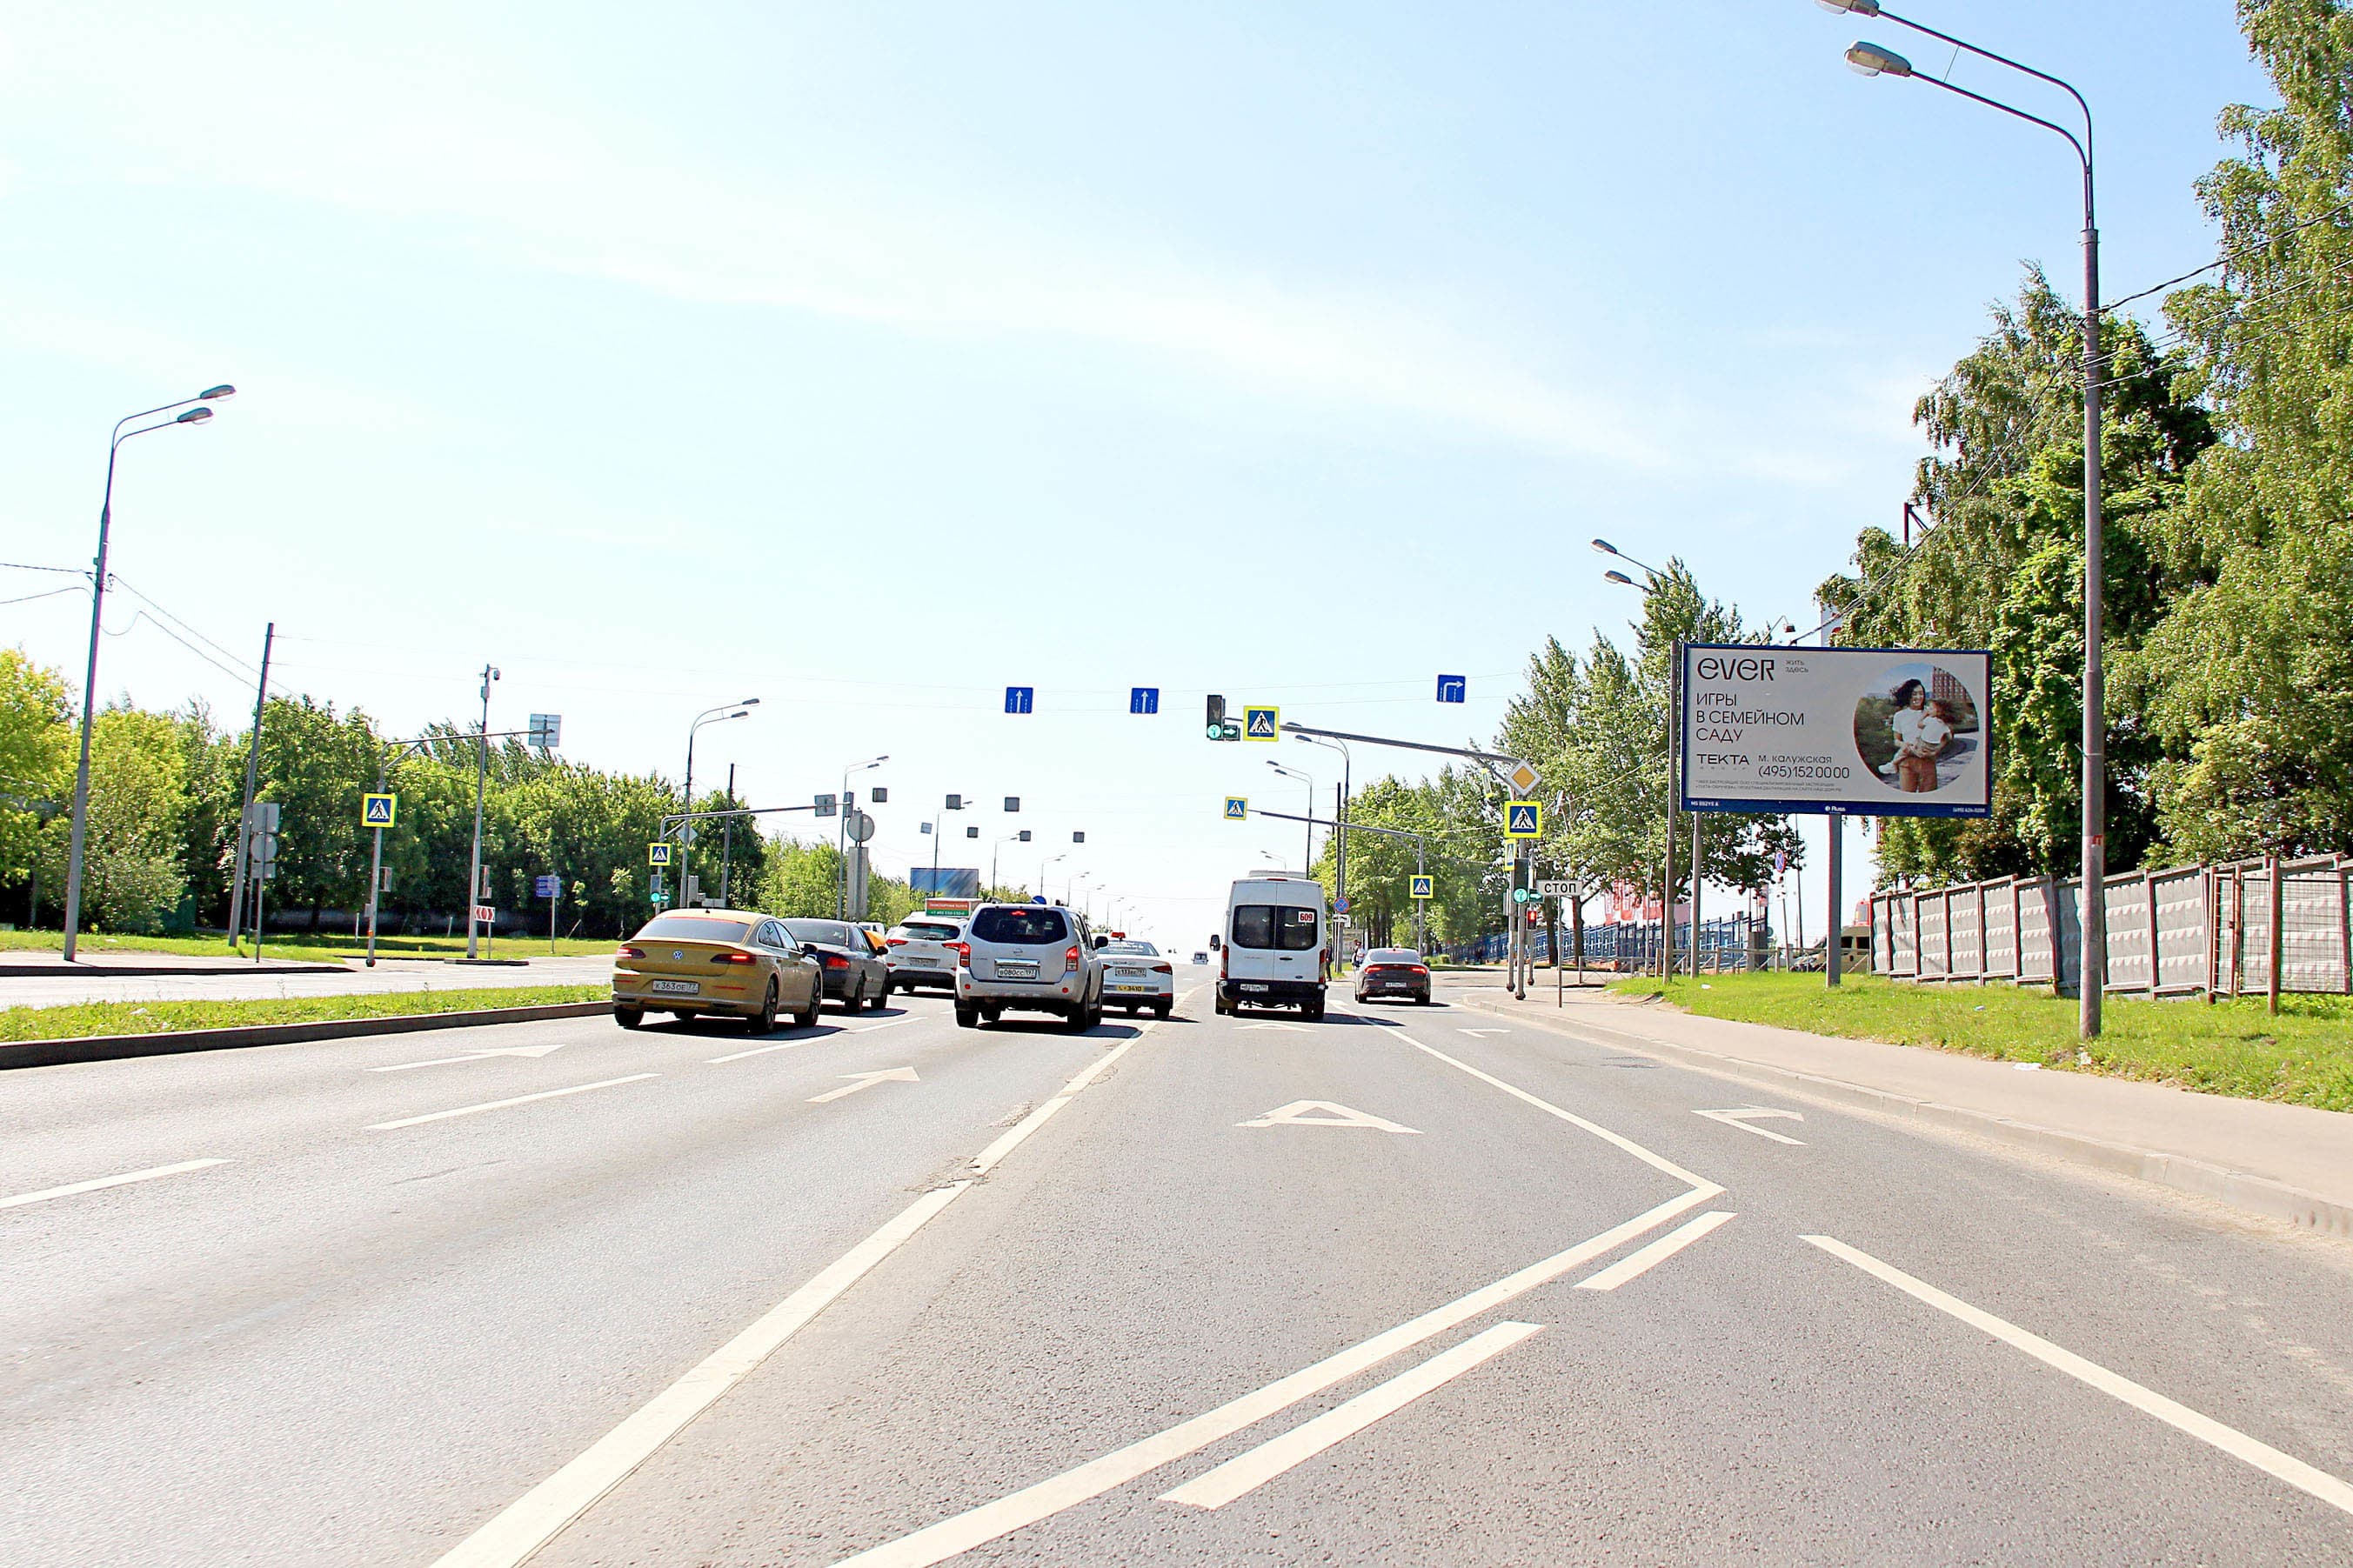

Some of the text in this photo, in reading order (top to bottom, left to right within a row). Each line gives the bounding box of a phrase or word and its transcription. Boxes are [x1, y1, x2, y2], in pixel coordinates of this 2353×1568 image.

[1696, 692, 1737, 706] ИГРЫ
[1696, 709, 1804, 725] В СЕМЕЙНОМ
[1695, 727, 1743, 744] САДУ
[1696, 753, 1749, 765] ТЕКТА
[1544, 883, 1576, 893] СТОП
[1300, 912, 1314, 922] 609
